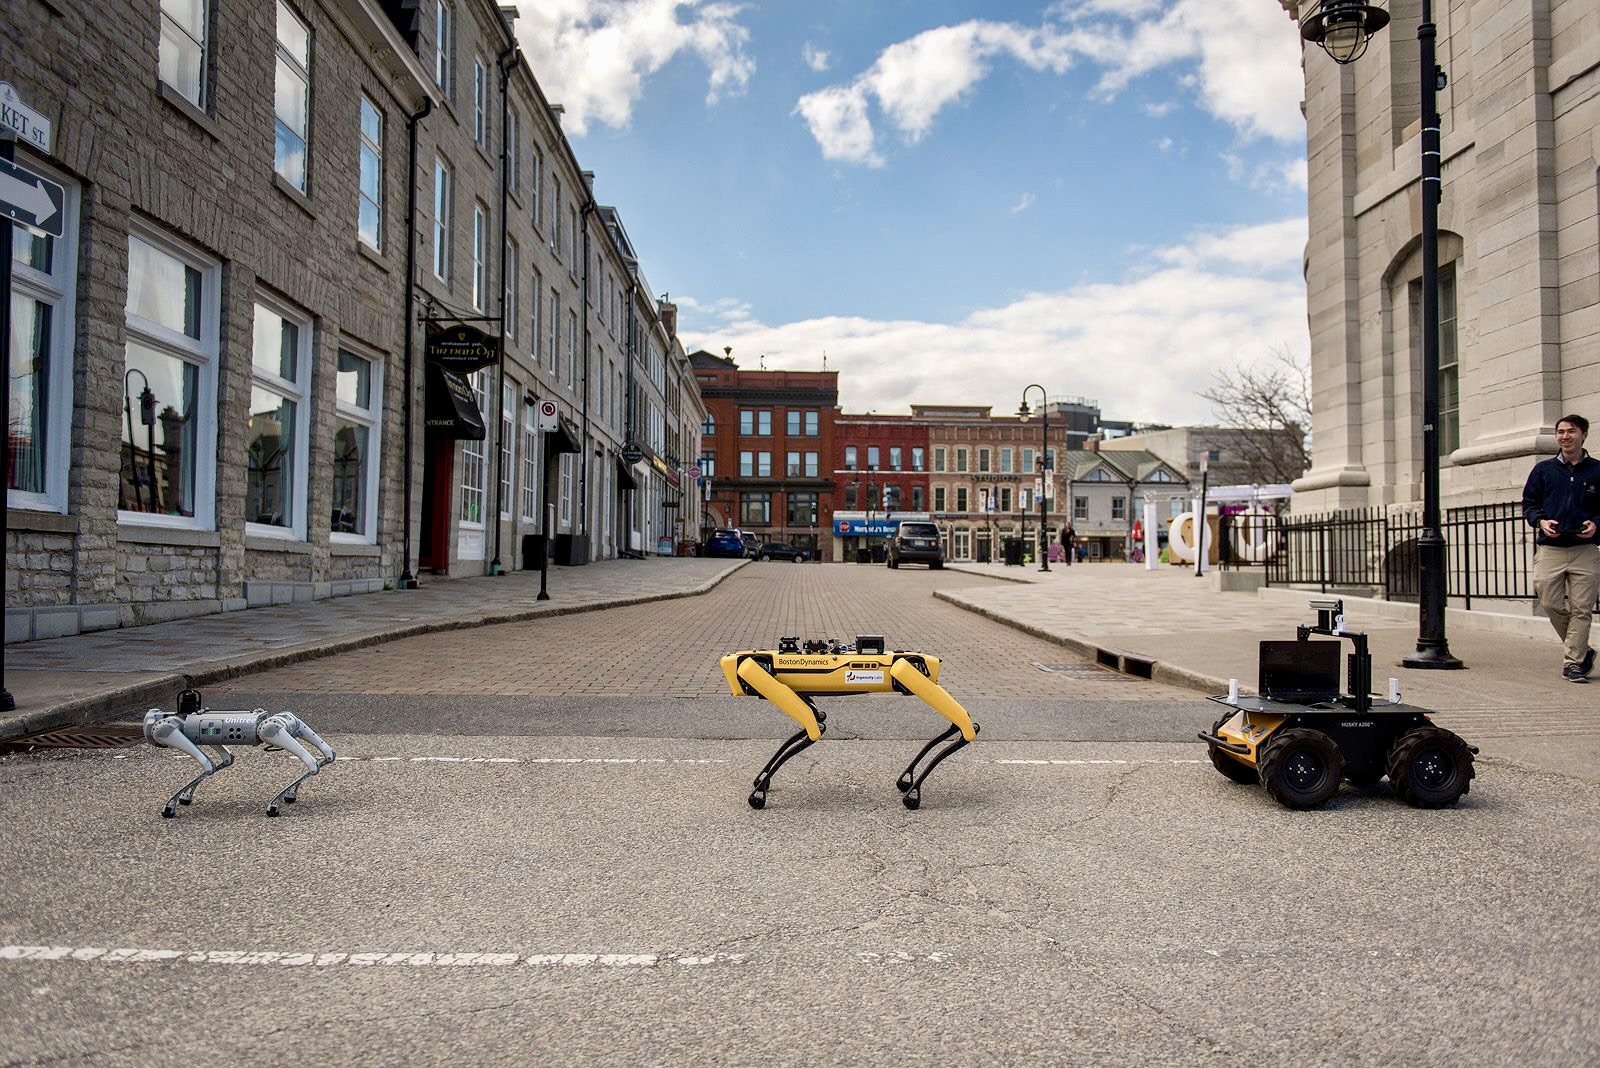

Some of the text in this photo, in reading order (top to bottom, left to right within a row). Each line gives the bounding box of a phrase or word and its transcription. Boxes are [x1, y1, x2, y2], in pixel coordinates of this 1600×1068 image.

[1, 102, 46, 146] KET ST.
[225, 716, 256, 724] Unitree
